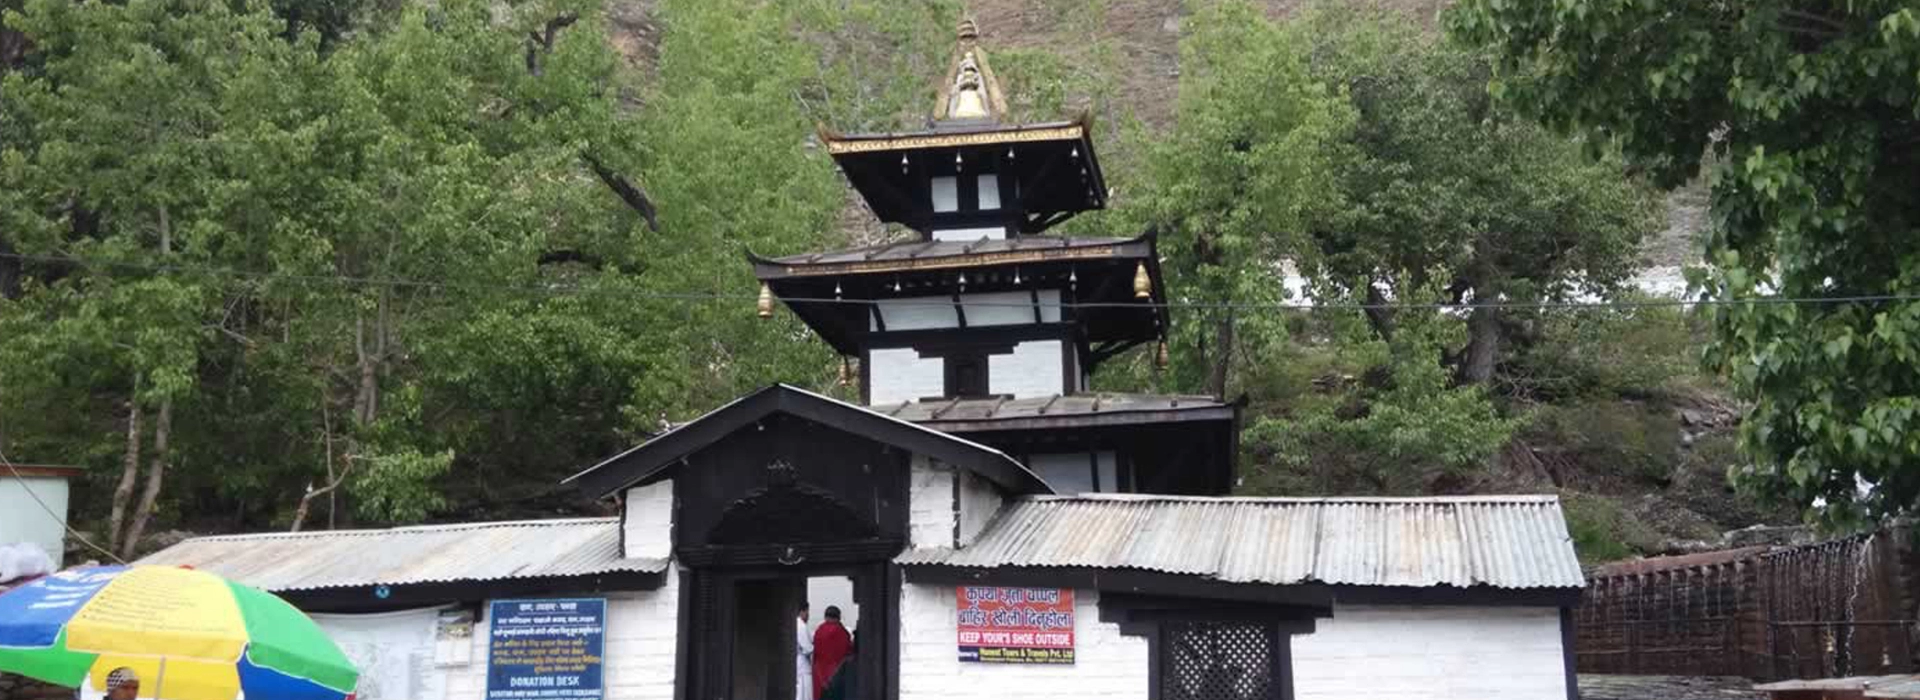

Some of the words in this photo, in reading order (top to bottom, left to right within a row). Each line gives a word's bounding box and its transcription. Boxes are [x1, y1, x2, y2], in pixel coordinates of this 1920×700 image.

[960, 631, 981, 644] KEEP
[1012, 633, 1034, 645] SHOE
[1035, 633, 1071, 645] OUTSIDE
[510, 675, 554, 687] DONATION
[556, 675, 580, 687] DESK
